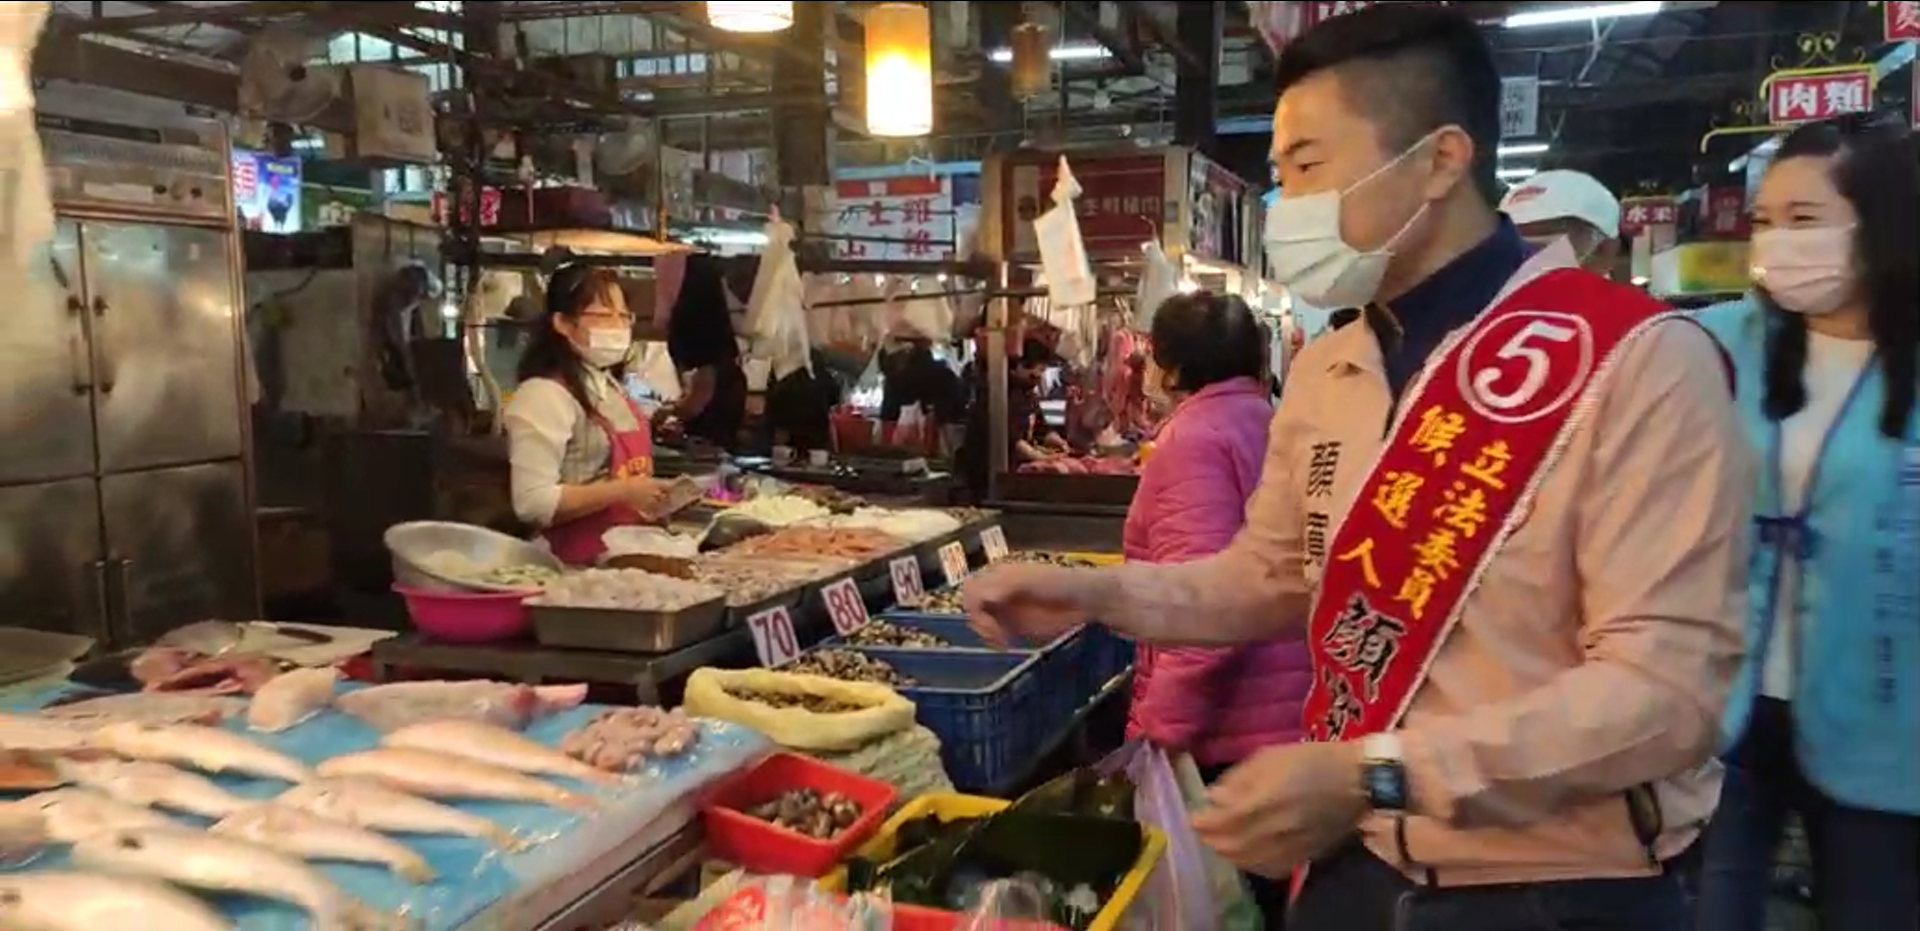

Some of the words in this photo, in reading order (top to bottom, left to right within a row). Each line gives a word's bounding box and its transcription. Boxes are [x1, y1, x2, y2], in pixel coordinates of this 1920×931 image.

[1777, 79, 1865, 117] 肉類
[1470, 317, 1580, 411] 5
[1335, 403, 1467, 589] 候選人
[1393, 440, 1513, 621] 立法委員
[827, 585, 867, 632] 80
[894, 560, 924, 600] 90
[755, 609, 795, 666] 70
